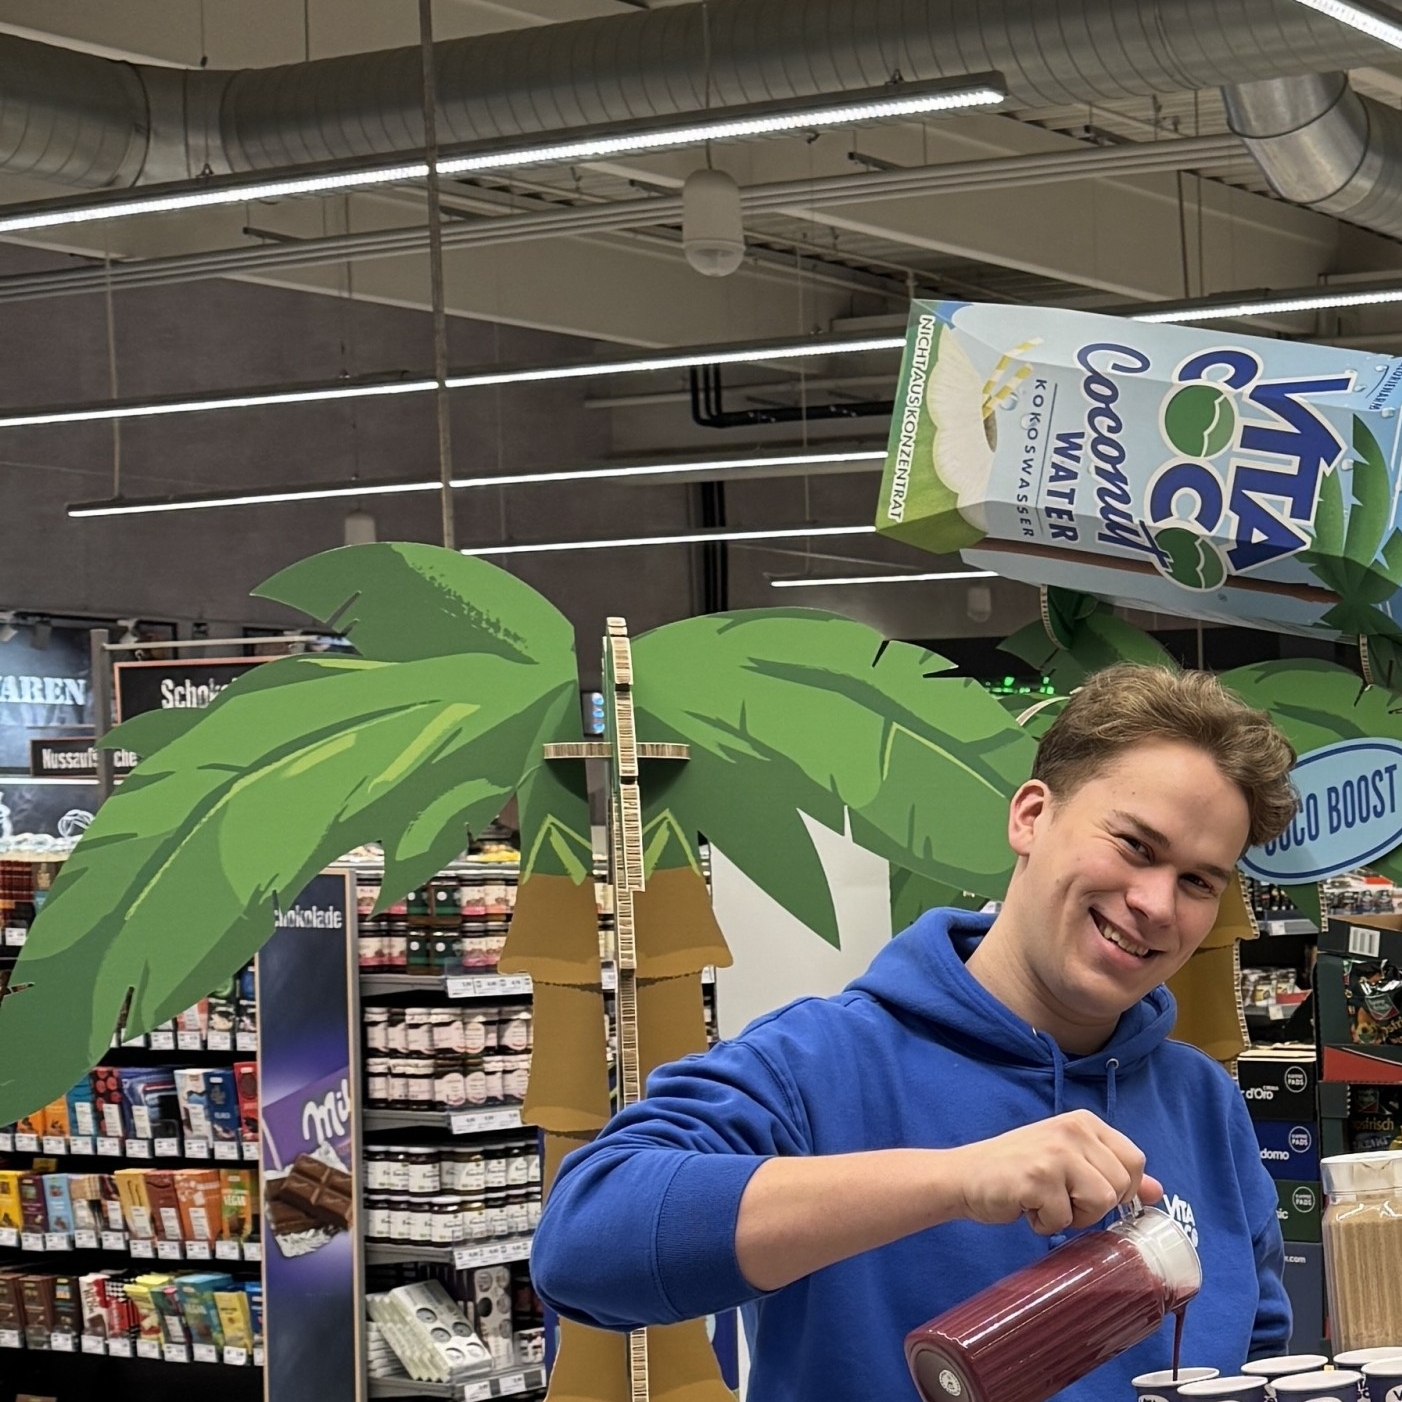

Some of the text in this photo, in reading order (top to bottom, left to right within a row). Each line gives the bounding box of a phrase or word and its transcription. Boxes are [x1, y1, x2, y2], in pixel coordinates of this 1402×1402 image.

[890, 316, 934, 519] NICHT AUS KONZENTRAT
[1016, 378, 1047, 537] KOKOSWASSER
[1077, 343, 1174, 573] Coconut
[1150, 350, 1258, 590] COCO
[1045, 431, 1085, 542] WATER
[1228, 377, 1351, 571] VITA
[0, 675, 87, 706] AREN
[1327, 764, 1397, 834] BOOST
[302, 1078, 352, 1145] Mil
[1260, 1149, 1289, 1160] domo
[1163, 1194, 1196, 1227] VITA
